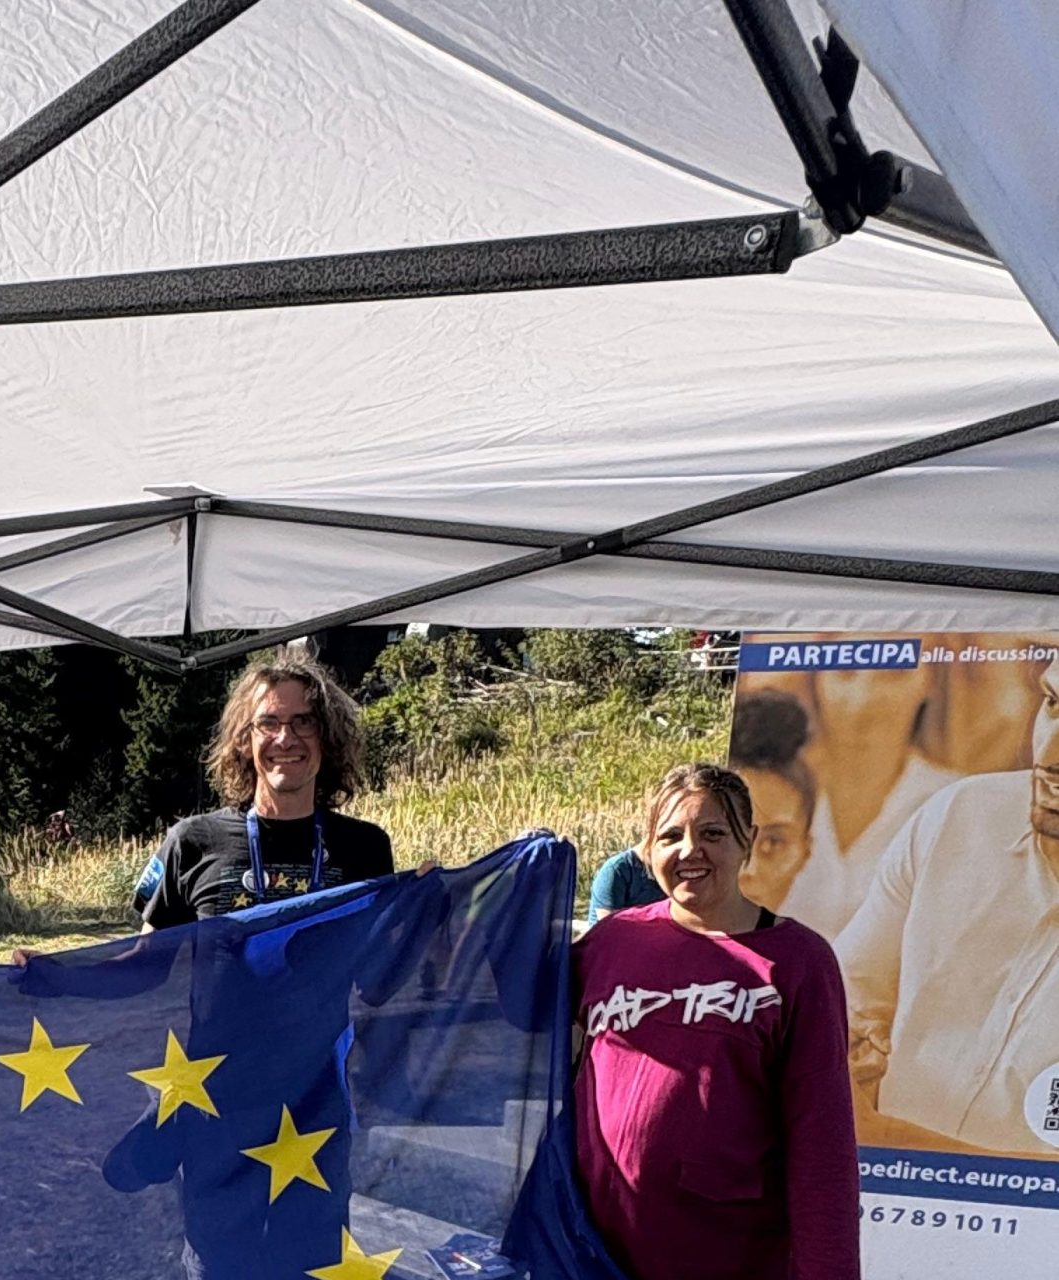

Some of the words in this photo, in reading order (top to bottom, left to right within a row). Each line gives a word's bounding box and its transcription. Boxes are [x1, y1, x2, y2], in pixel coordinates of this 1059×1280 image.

[768, 643, 916, 666] PARTECIPA
[921, 647, 954, 663] alla
[673, 981, 783, 1024] TRIP
[870, 1206, 885, 1222] 6
[891, 1208, 905, 1224] 7
[911, 1209, 926, 1226] 8
[932, 1211, 947, 1228] 9
